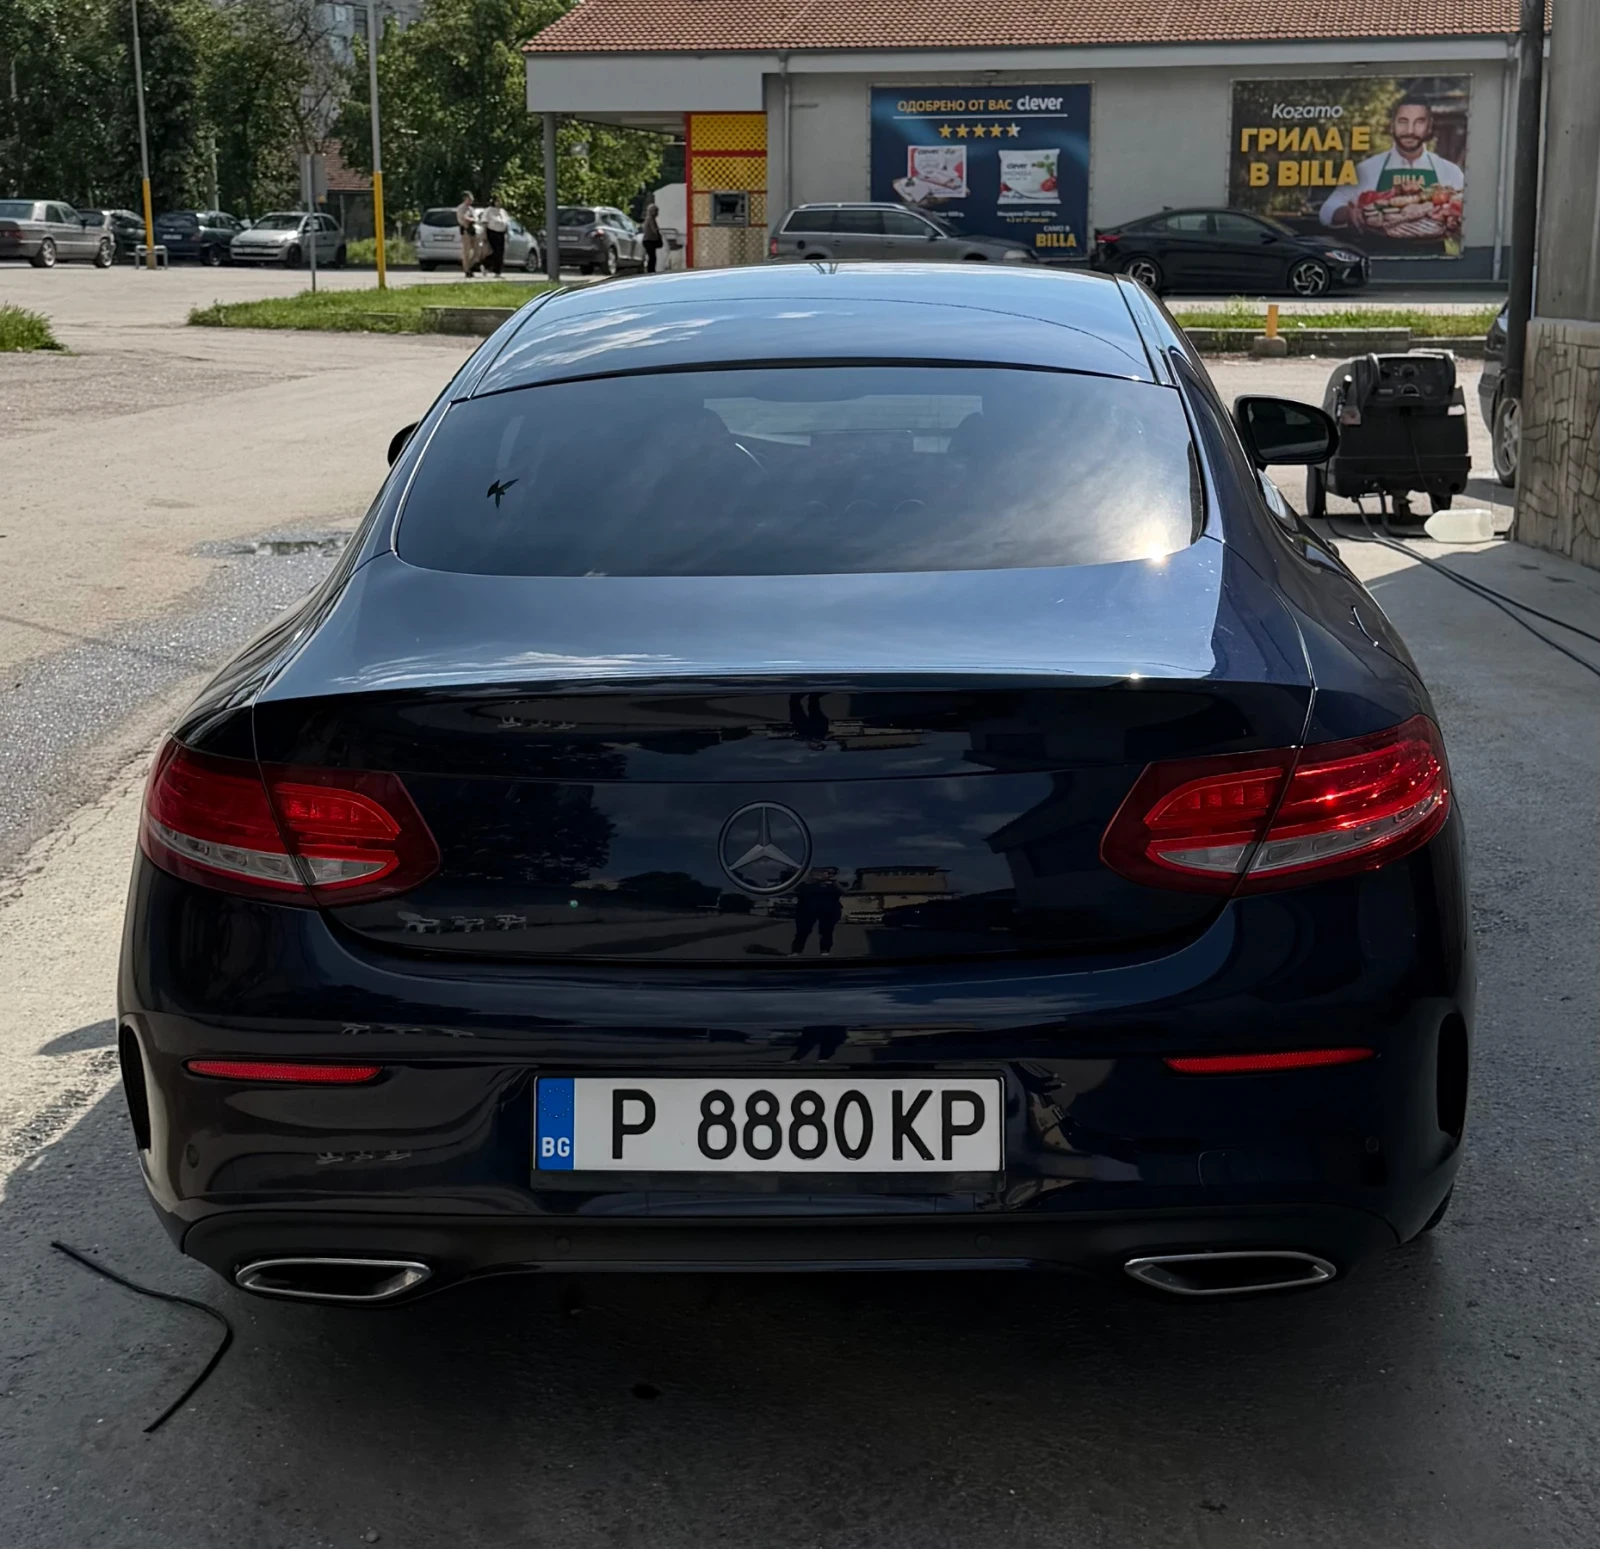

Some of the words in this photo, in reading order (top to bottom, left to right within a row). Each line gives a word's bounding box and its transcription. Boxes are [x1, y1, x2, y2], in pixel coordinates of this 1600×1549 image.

[898, 99, 966, 113] ОДОБРЕНО
[968, 98, 985, 111] ОТ
[988, 99, 1013, 111] ВАС
[1016, 95, 1064, 111] clever
[1272, 103, 1344, 119] Когато
[1240, 127, 1345, 152] ГРИЛА
[1351, 126, 1371, 151] Е
[1250, 162, 1270, 187] В
[1277, 159, 1359, 187] BILLA
[1393, 174, 1426, 186] BILLA
[1035, 233, 1077, 248] BILLA
[611, 1088, 657, 1160] P
[697, 1089, 875, 1161] 8880
[891, 1089, 986, 1161] KP
[540, 1137, 571, 1158] BG
